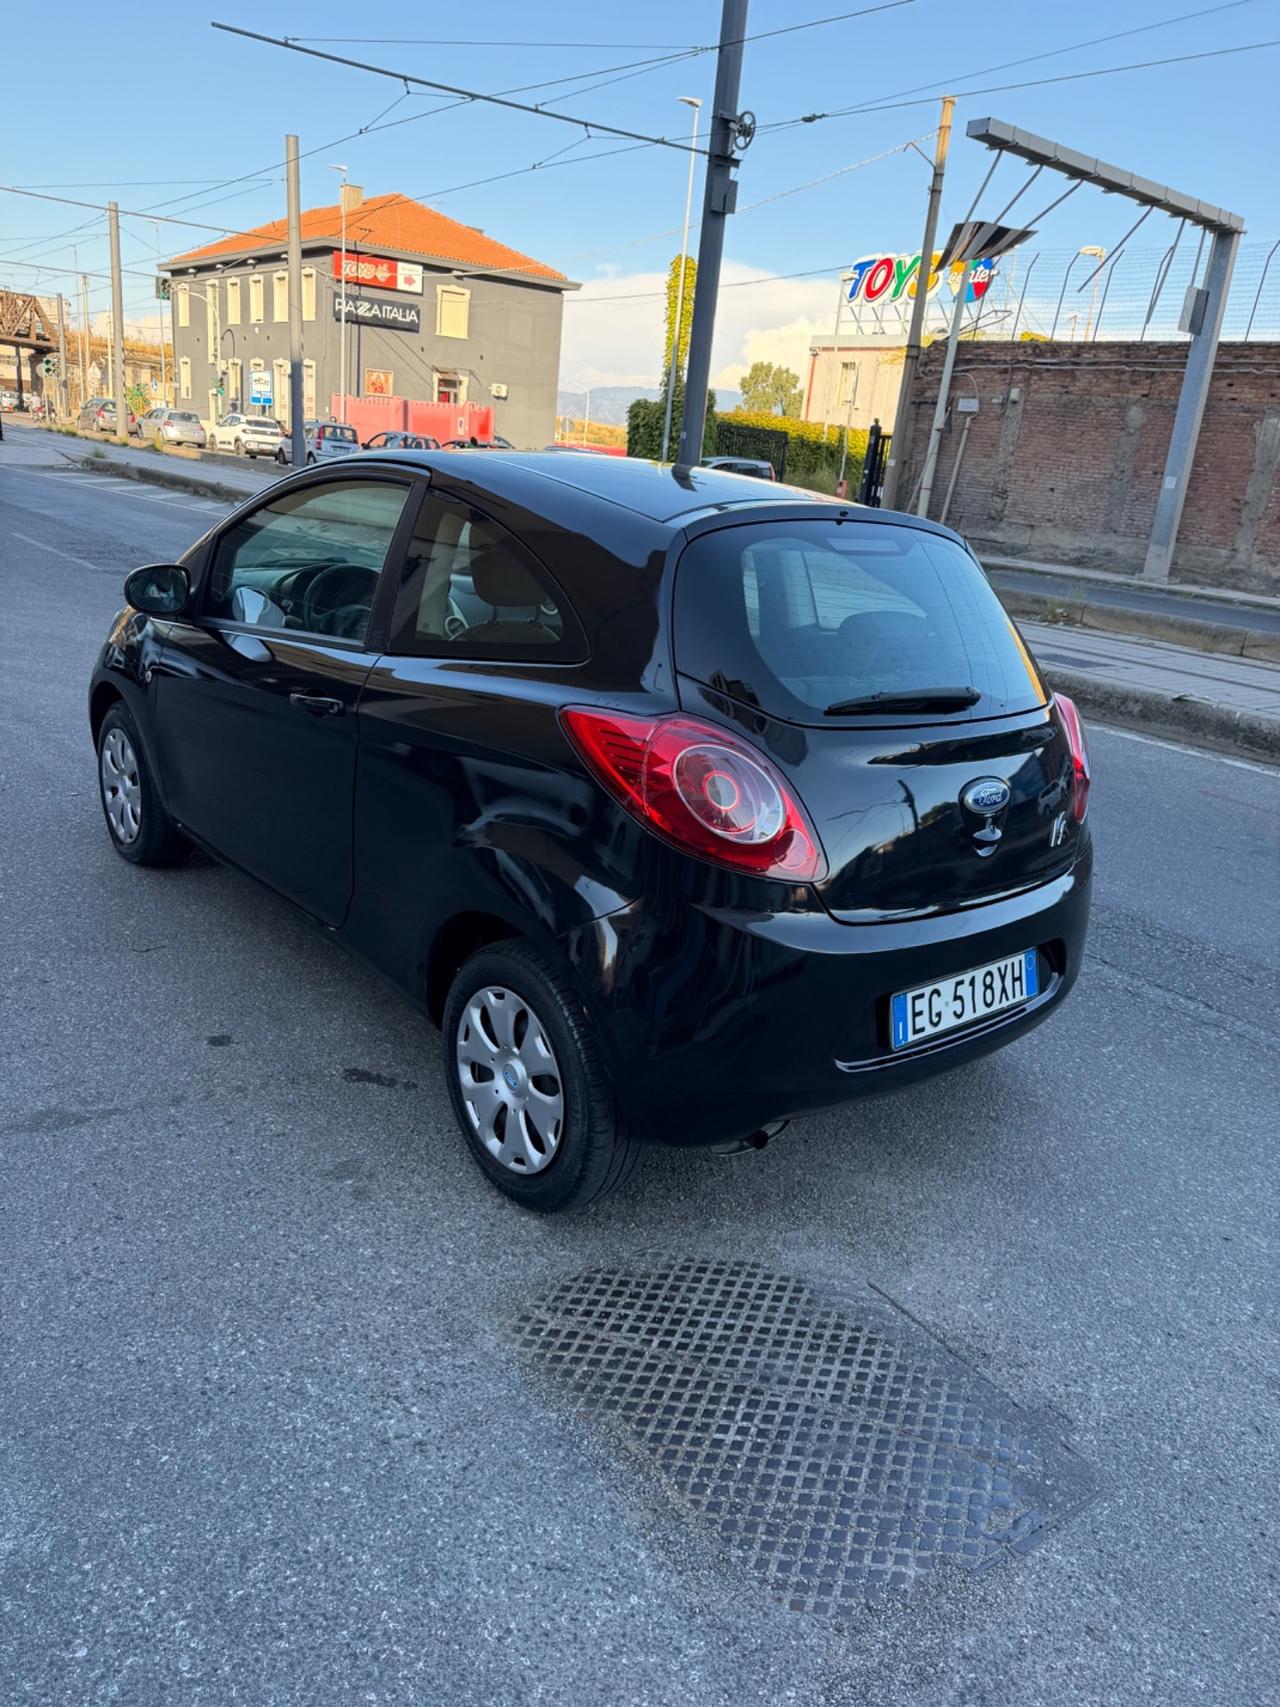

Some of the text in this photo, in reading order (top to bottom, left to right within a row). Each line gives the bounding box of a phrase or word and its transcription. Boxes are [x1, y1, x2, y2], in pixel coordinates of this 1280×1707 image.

[848, 253, 941, 302] TOYS
[335, 298, 419, 323] PAZZA ITALIA
[911, 959, 1024, 1036] EG 518XH
